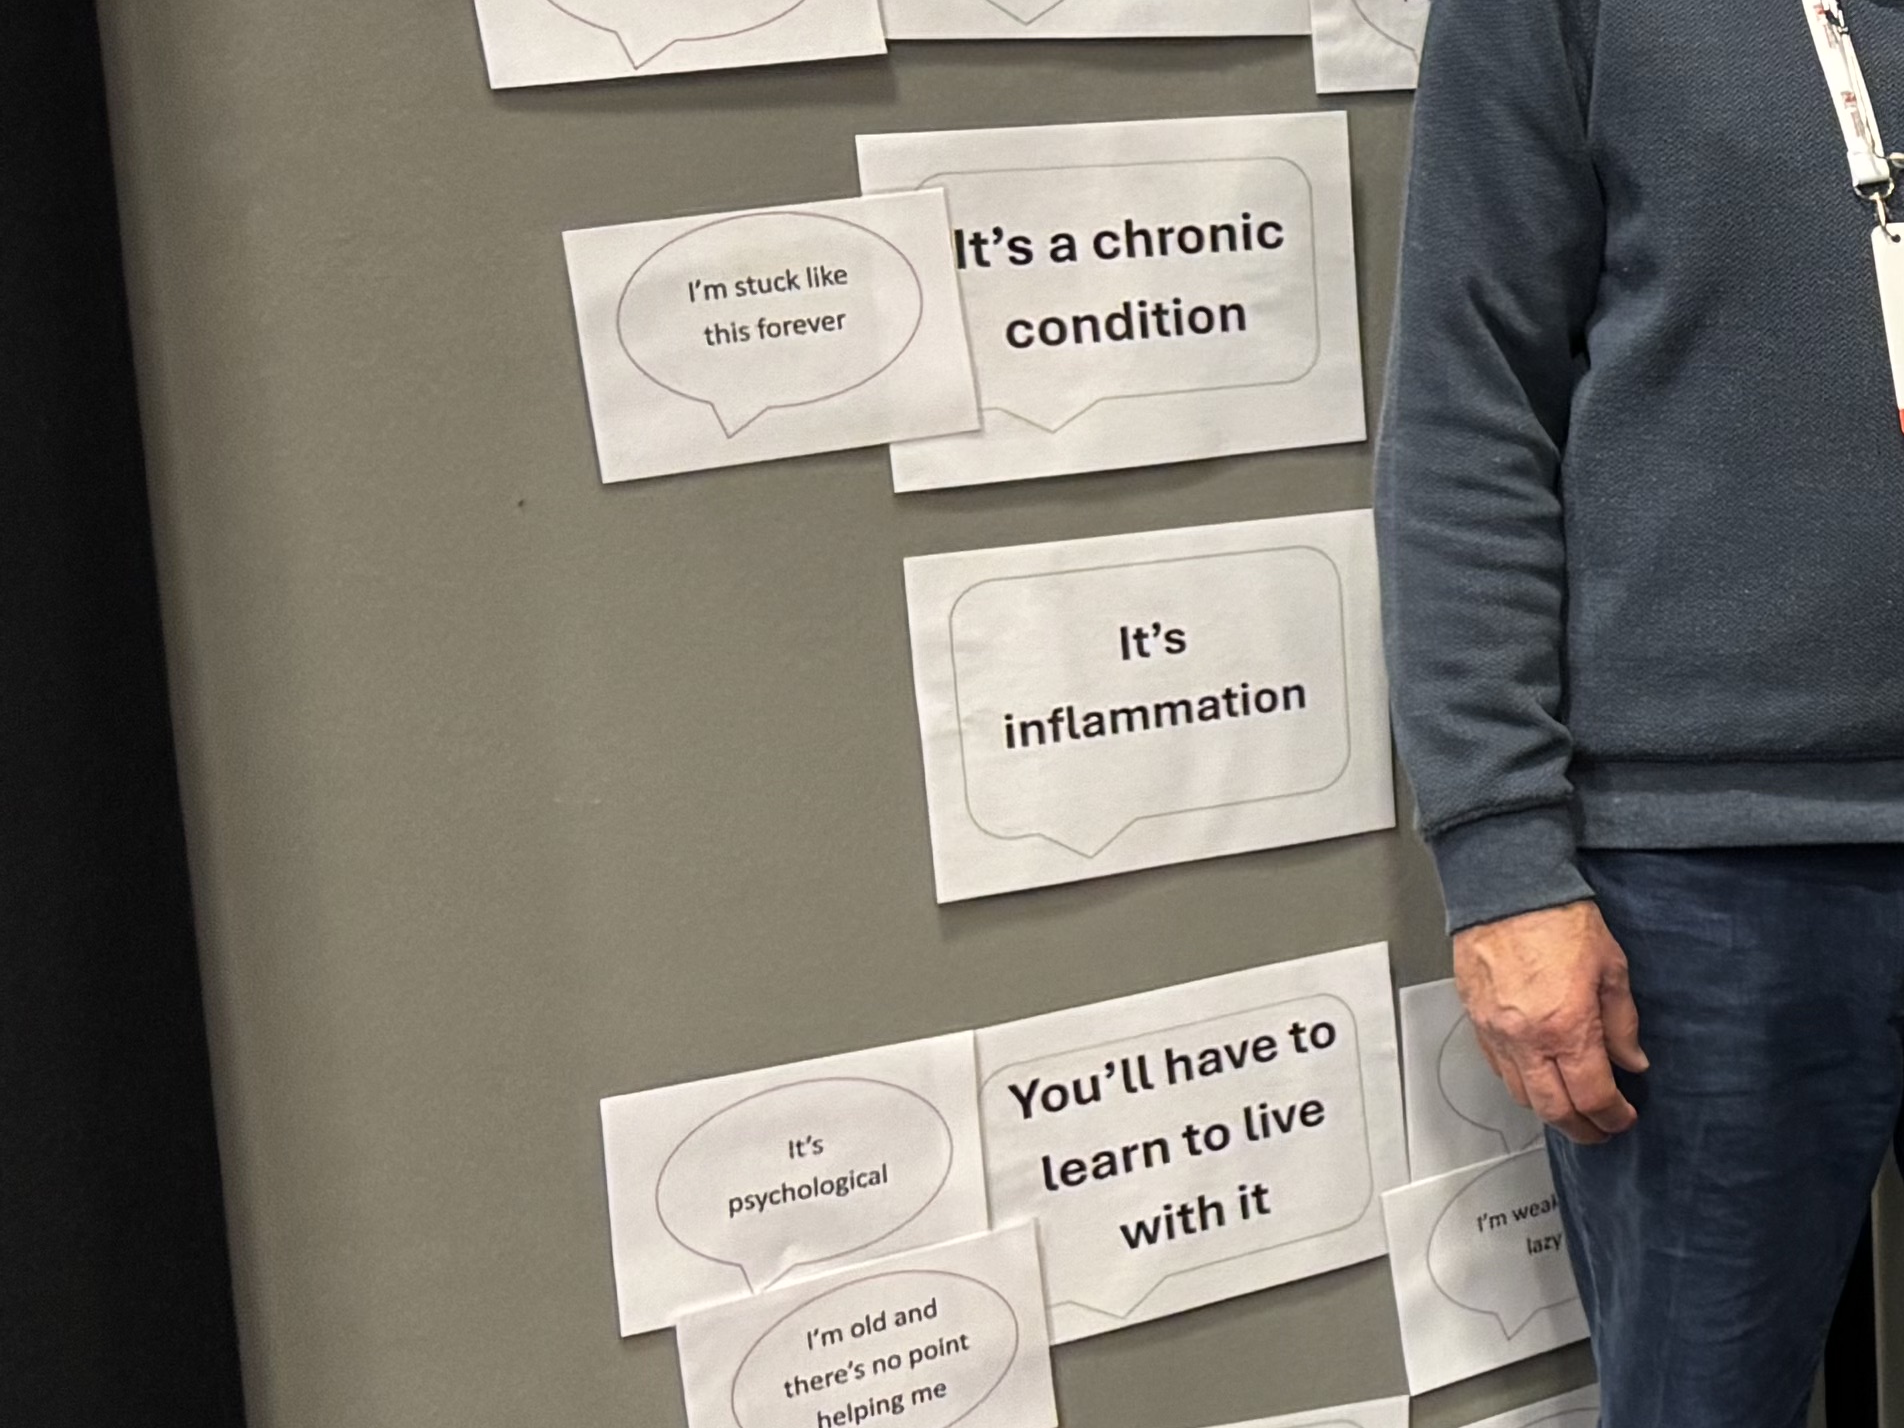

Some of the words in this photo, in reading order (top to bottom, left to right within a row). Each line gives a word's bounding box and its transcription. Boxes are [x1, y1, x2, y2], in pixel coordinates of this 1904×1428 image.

[954, 227, 1033, 269] It's
[1050, 233, 1077, 263] a
[1093, 212, 1283, 259] chronic
[689, 280, 727, 302] I'm
[735, 269, 800, 297] stuck
[807, 265, 847, 288] like
[704, 322, 750, 346] this
[757, 314, 845, 339] forever
[1006, 298, 1246, 348] condition
[1120, 622, 1186, 660] It's
[1006, 684, 1305, 748] inflammation
[1008, 1055, 1154, 1119] You'll
[1165, 1036, 1277, 1084] have
[1288, 1022, 1335, 1053] to
[1042, 1138, 1170, 1191] learn
[1182, 1124, 1230, 1155] to
[1244, 1100, 1324, 1141] live
[1120, 1195, 1225, 1249] with
[1239, 1184, 1270, 1219] it
